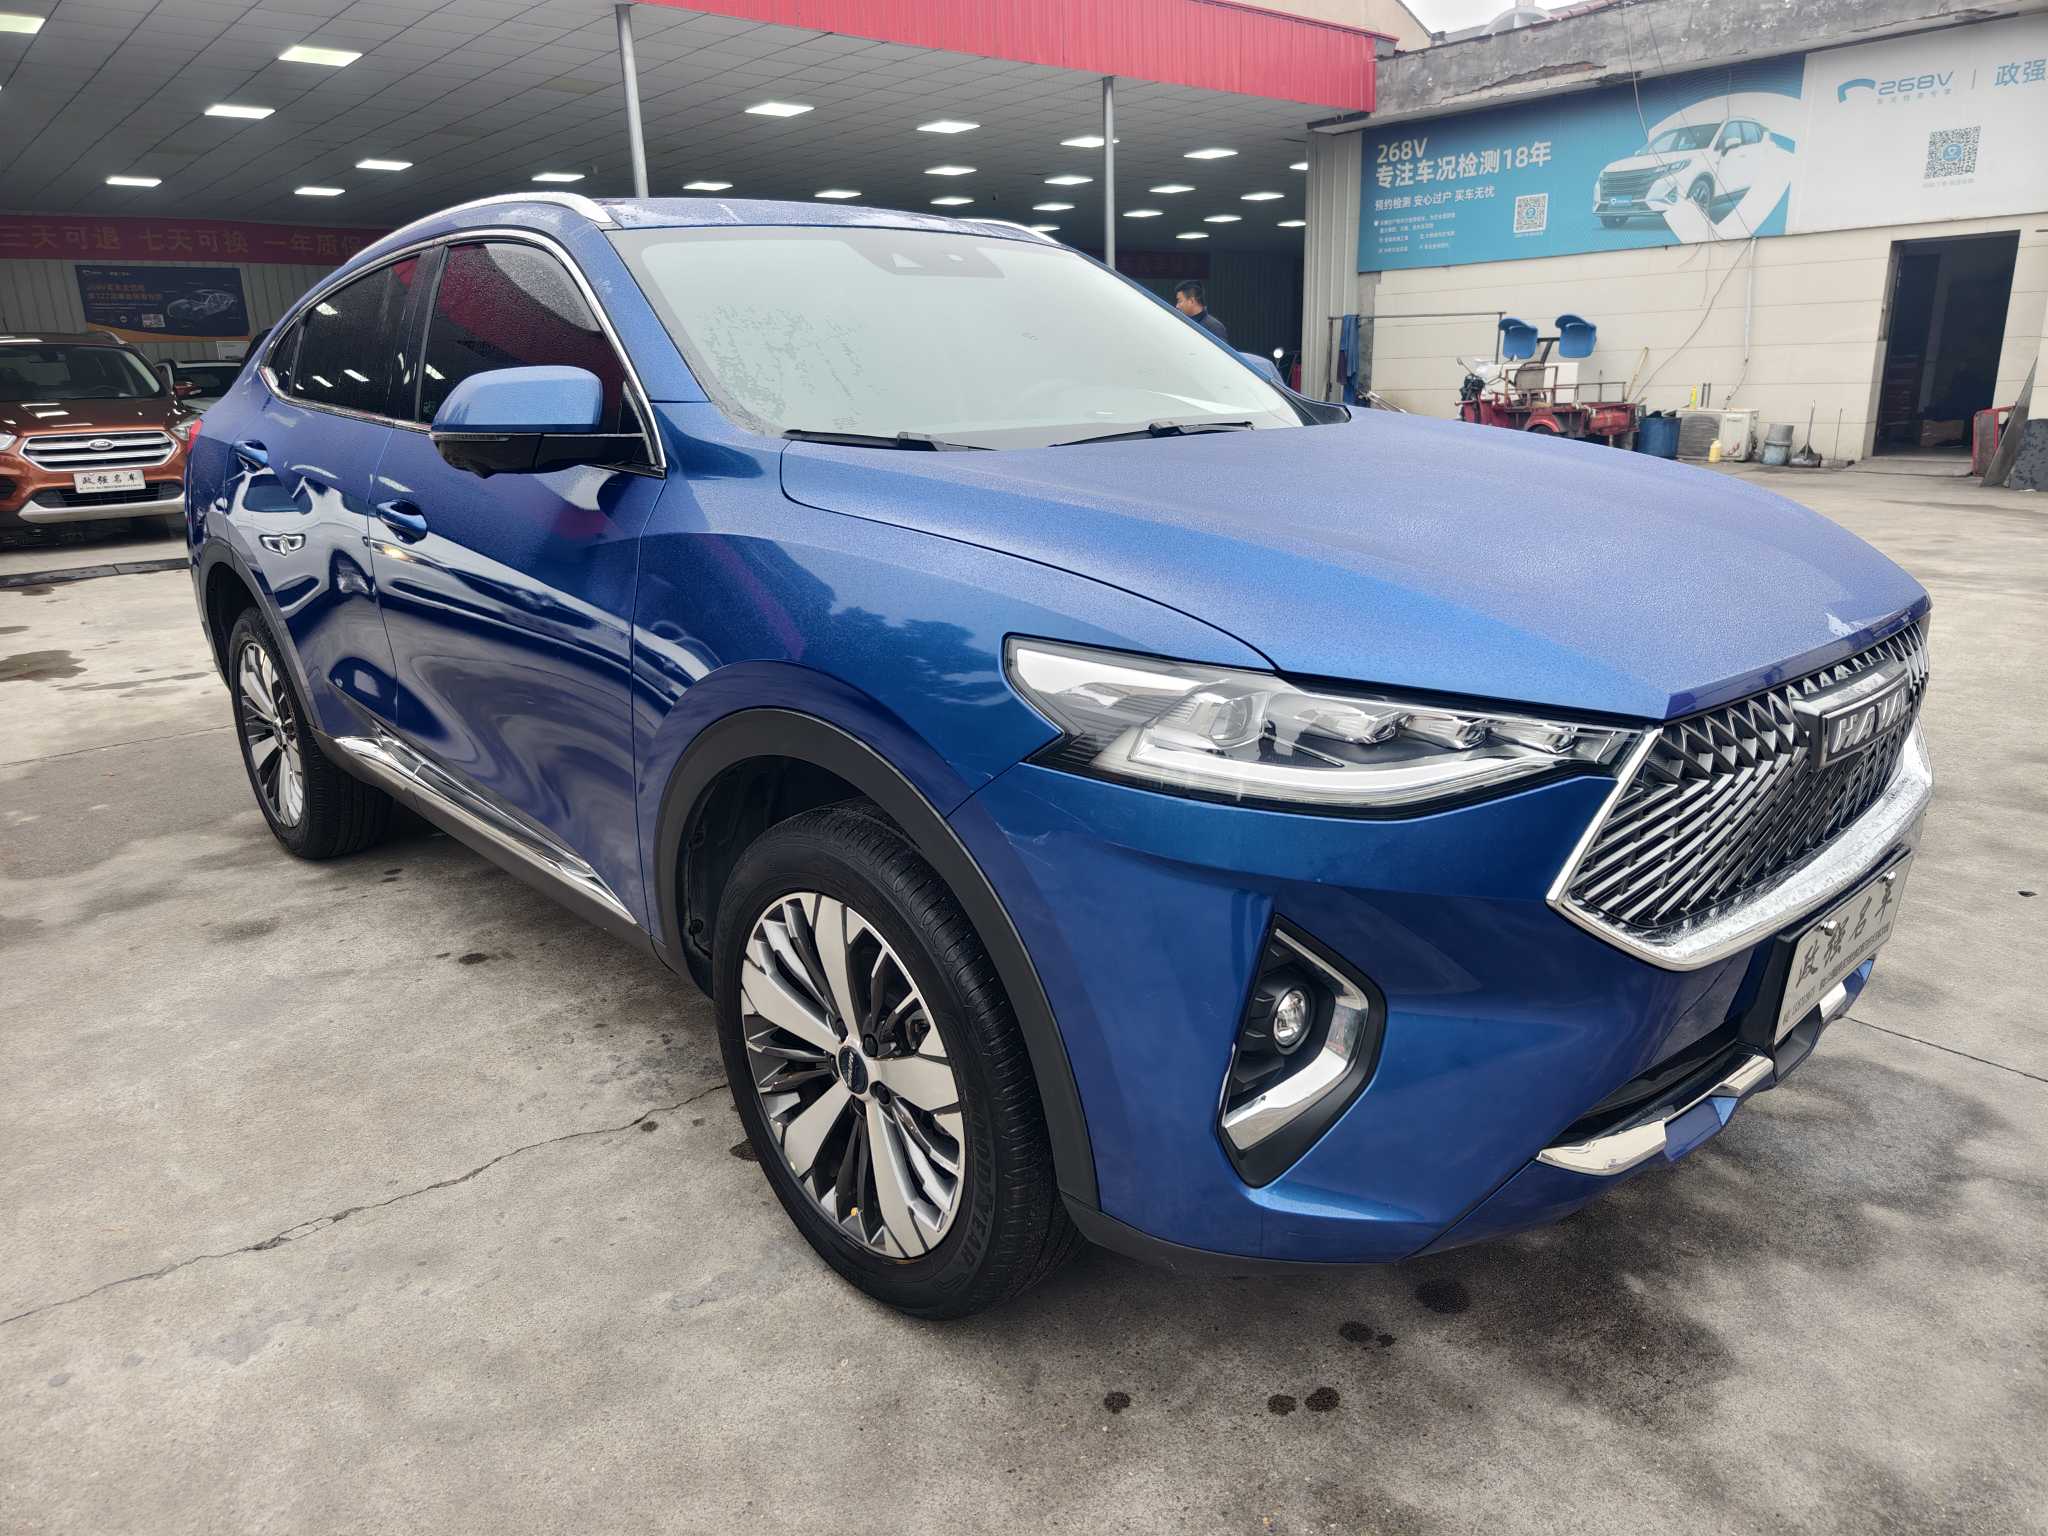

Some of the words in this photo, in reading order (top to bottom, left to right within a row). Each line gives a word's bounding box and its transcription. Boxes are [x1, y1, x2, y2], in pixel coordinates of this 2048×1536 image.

[1878, 71, 1954, 96] 268V
[1376, 137, 1428, 163] 268V
[1375, 140, 1552, 190] 专注车况检测18年
[1413, 191, 1453, 208] 安心过户
[1454, 184, 1496, 203] 买车无忧
[0, 224, 121, 251] 三天可退
[137, 227, 249, 255] 七天可换
